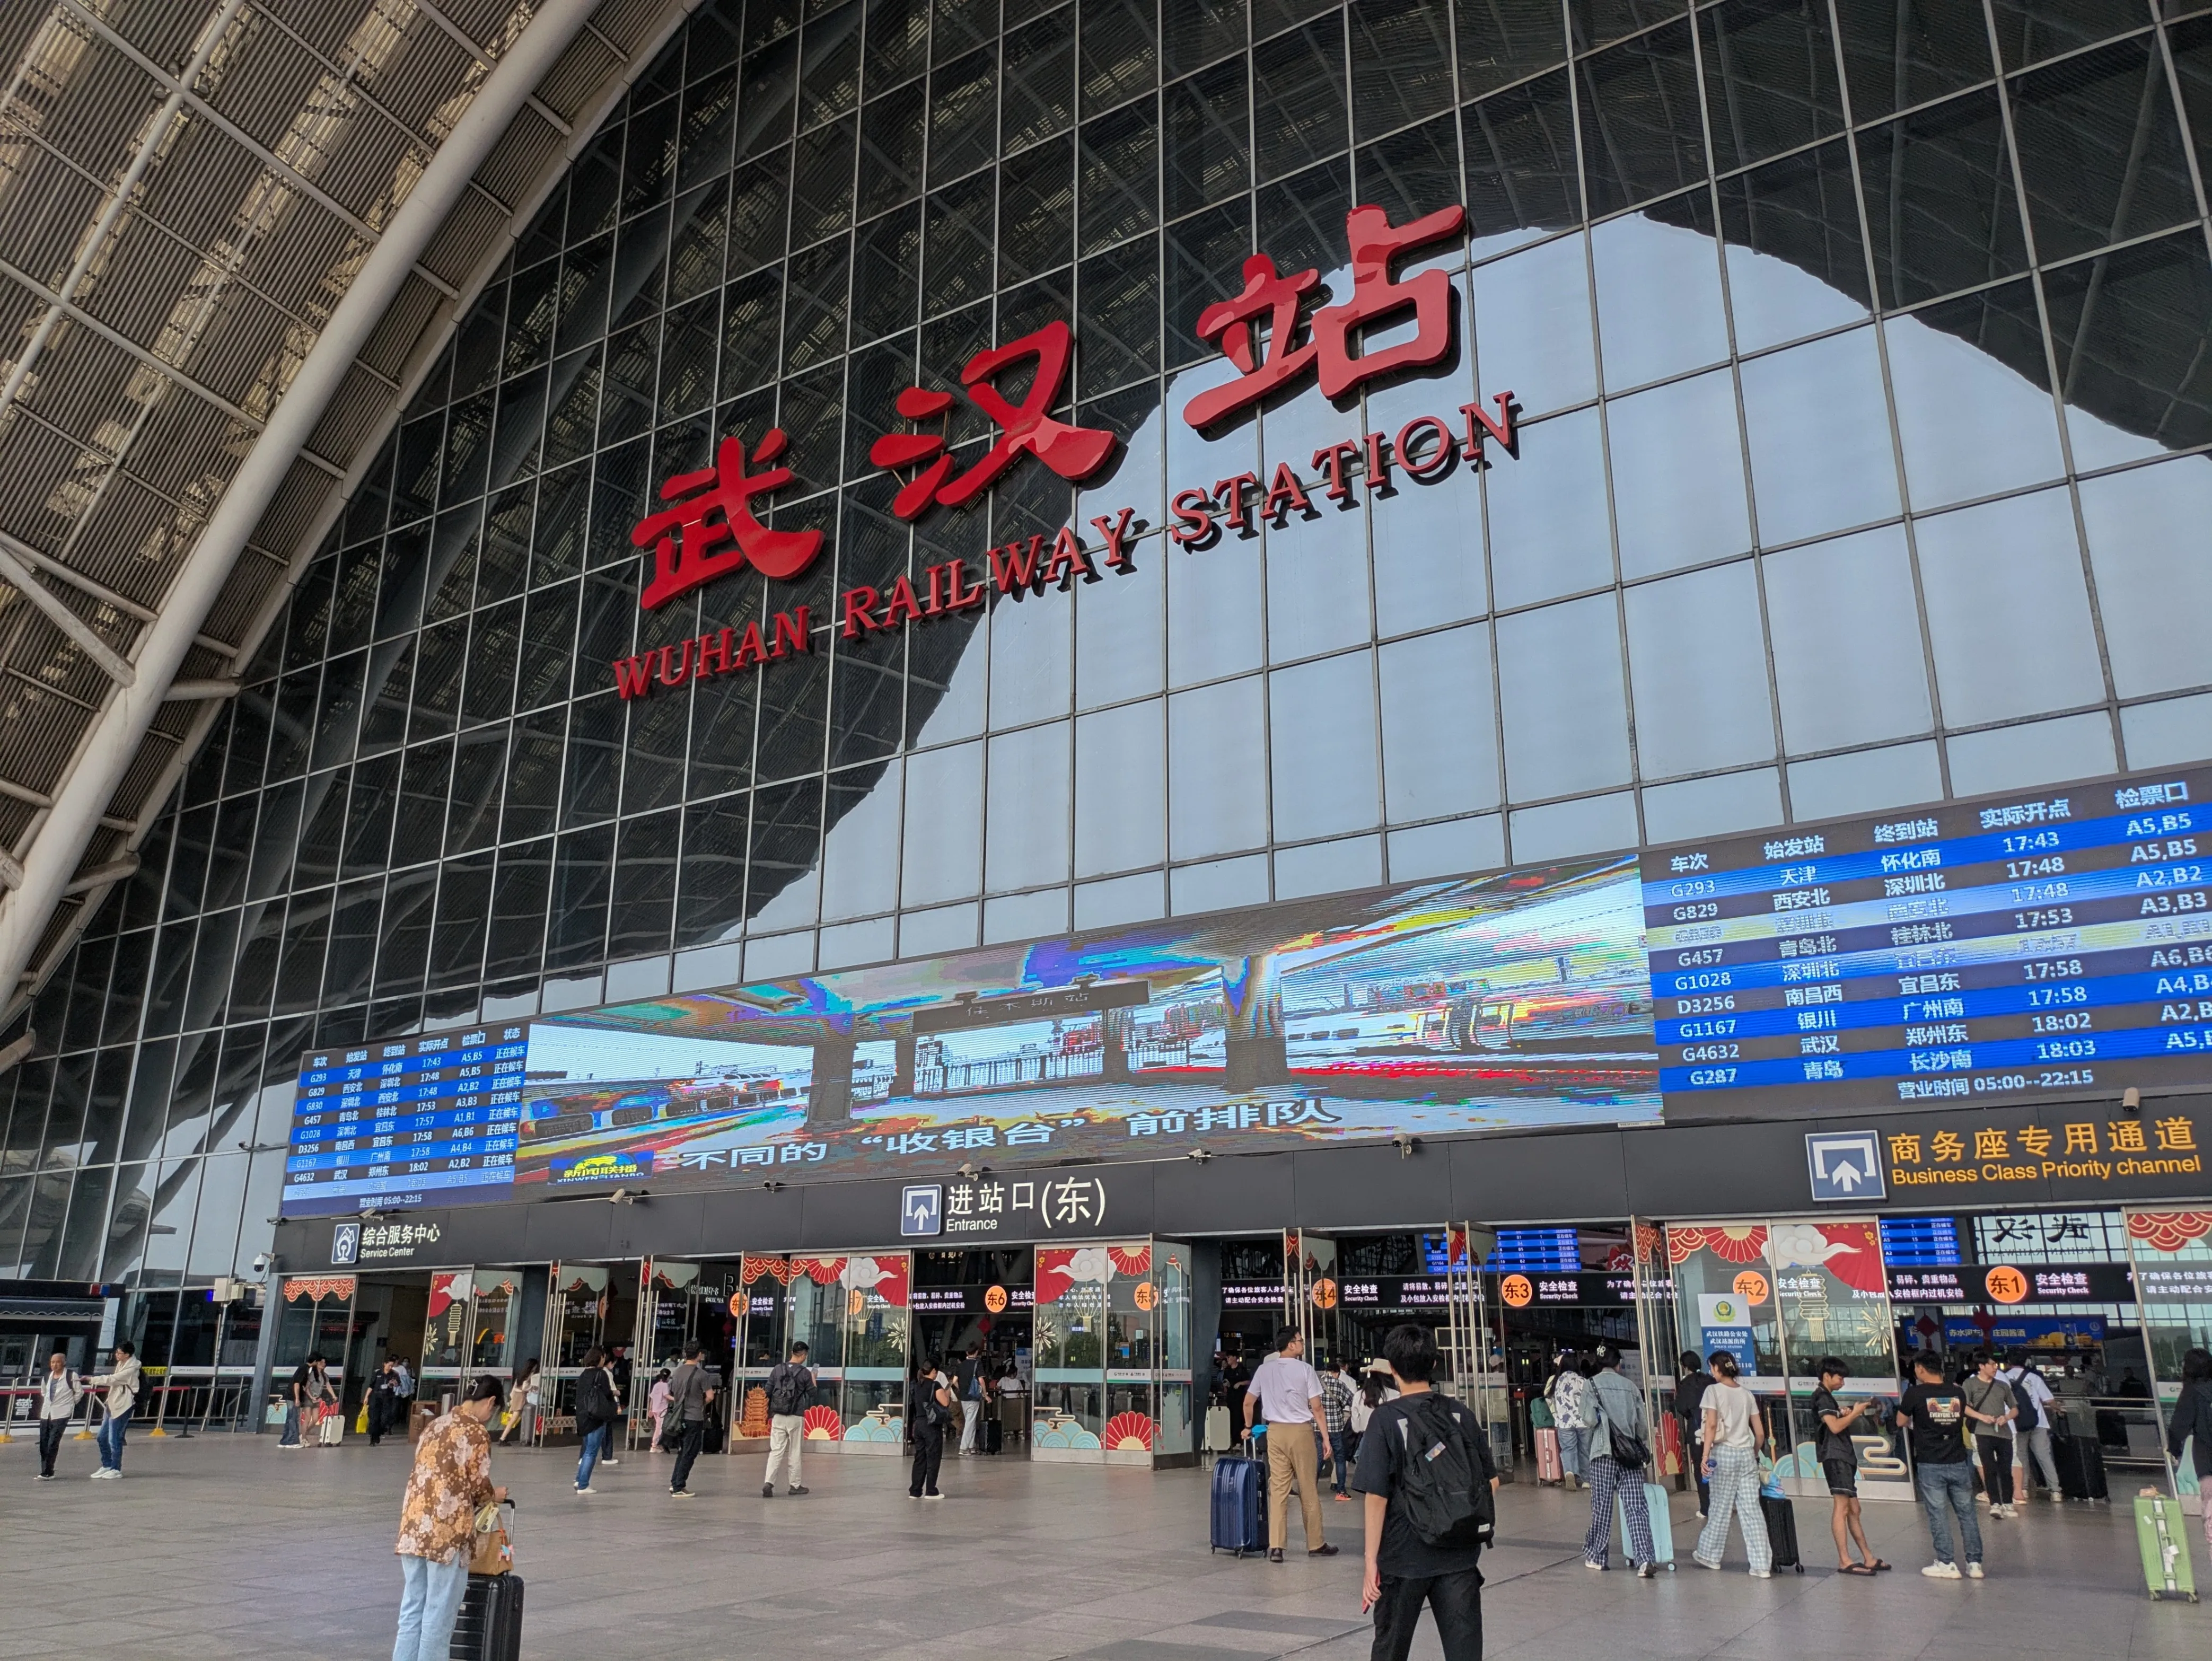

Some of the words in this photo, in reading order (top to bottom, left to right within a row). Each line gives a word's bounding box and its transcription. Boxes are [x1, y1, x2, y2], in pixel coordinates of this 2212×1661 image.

[630, 204, 1463, 610] 武汉站
[612, 605, 810, 700] WUHAN
[841, 509, 1132, 637] RAILWAY
[1171, 393, 1510, 541] STATION
[1671, 853, 1708, 872] 车次
[1764, 835, 1824, 859] 始发站
[1874, 819, 1938, 842] 终到站
[1980, 798, 2071, 829] 实际开点
[2115, 781, 2189, 809] 检票口
[1671, 880, 1715, 897] G293
[1780, 866, 1816, 885] 天津
[1881, 849, 1941, 872] 怀化南
[2003, 832, 2059, 853] 17:43
[2126, 813, 2191, 835] A5,B5
[1674, 903, 1718, 920] G829
[1772, 887, 1830, 911] 西安北
[1884, 873, 1945, 897] 深圳北
[2007, 857, 2064, 878] 17:48
[2131, 839, 2197, 862] A5,B5
[2011, 882, 2068, 902] 17:48
[2136, 866, 2201, 887] A2,B2
[1678, 948, 1724, 966] G457
[1779, 936, 1837, 958] 青岛北
[1891, 922, 1953, 945] 桂林北
[2015, 908, 2073, 929] 17:53
[2140, 892, 2207, 914] A3,B3
[1675, 972, 1731, 990] G1028
[1781, 961, 1840, 982] 深圳北
[1678, 996, 1735, 1014] D3256
[1785, 985, 1842, 1006] 南昌西
[1898, 973, 1961, 995] 宜昌东
[2024, 960, 2083, 980] 17:58
[1680, 1020, 1736, 1038] G1167
[1797, 1009, 1837, 1030] 银川
[1903, 998, 1964, 1021] 广州南
[2028, 986, 2087, 1006] 17:58
[313, 1056, 328, 1068] 车次
[346, 1050, 368, 1063] 始发站
[383, 1044, 406, 1057] 终到站
[418, 1038, 449, 1052] 实际开点
[462, 1030, 486, 1047] 检票口
[504, 1027, 521, 1040] 状态
[1682, 1044, 1740, 1061] G4632
[1800, 1035, 1840, 1054] 武汉
[1906, 1024, 1969, 1046] 郑州东
[2032, 1013, 2092, 1033] 18:02
[308, 1087, 325, 1097] G829
[343, 1082, 363, 1094] 西安北
[380, 1077, 401, 1089] 深圳北
[420, 1072, 440, 1083] 17:48
[459, 1066, 481, 1078] A5,B5
[494, 1060, 524, 1074] 正在候车
[310, 1073, 327, 1083] G293
[348, 1068, 362, 1079] 天津
[382, 1062, 403, 1075] 怀化南
[423, 1057, 441, 1068] 17:43
[461, 1051, 482, 1062] A5,B5
[495, 1045, 525, 1059] 正在候车
[1690, 1068, 1737, 1085] G287
[1803, 1060, 1843, 1080] 青岛
[1909, 1049, 1972, 1073] 长沙南
[2037, 1040, 2096, 1059] 18:03
[306, 1101, 323, 1111] G830
[340, 1096, 361, 1109] 深圳北
[378, 1091, 399, 1104] 西安北
[418, 1087, 437, 1097] 17:48
[458, 1082, 479, 1093] A2,B2
[491, 1076, 522, 1089] 正在候车
[1898, 1078, 1969, 1100] 营业时间
[1974, 1069, 2094, 1091] 05:00--22:15
[301, 1130, 321, 1139] G1028
[337, 1125, 357, 1138] 深圳北
[374, 1121, 396, 1133] 宜昌东
[415, 1116, 434, 1127] 17:57
[454, 1112, 475, 1123] A1,B1
[488, 1106, 519, 1120] 正在候车
[304, 1115, 321, 1125] G457
[339, 1110, 359, 1123] 青岛北
[376, 1106, 397, 1118] 桂林北
[417, 1101, 436, 1112] 17:53
[455, 1096, 477, 1108] A3,B3
[490, 1091, 520, 1105] 正在候车
[298, 1144, 319, 1154] D3256
[335, 1139, 355, 1152] 南昌西
[373, 1136, 394, 1147] 宜昌东
[413, 1131, 432, 1142] 17:58
[452, 1127, 474, 1138] A6,B6
[487, 1122, 517, 1136] 正在候车
[680, 1141, 828, 1170] 不同的
[1126, 1100, 1340, 1137] 前排队
[1887, 1116, 2197, 1165] 商务座专用通道
[294, 1173, 314, 1182] G4632
[333, 1170, 348, 1180] 武汉
[368, 1166, 390, 1177] 郑州东
[409, 1162, 428, 1172] 18:02
[448, 1158, 470, 1169] A2,B2
[482, 1154, 513, 1167] 正在候车
[296, 1158, 317, 1168] G1167
[336, 1155, 350, 1165] 银川
[371, 1150, 391, 1162] 广州南
[411, 1147, 430, 1157] 17:58
[450, 1143, 472, 1154] A4,B4
[485, 1138, 515, 1152] 正在候车
[564, 1164, 637, 1177] 新闻联播
[1892, 1165, 1979, 1186] Business
[1981, 1163, 2038, 1181] Class
[2042, 1158, 2111, 1180] Priority
[2116, 1154, 2201, 1175] channel
[362, 1223, 441, 1246] 综合服务中心
[946, 1218, 998, 1232] Entrance
[361, 1247, 387, 1259] Service
[389, 1247, 415, 1257] Center
[1345, 1284, 1378, 1294] 安全检查
[1504, 1282, 1529, 1299] 东3
[1539, 1280, 1577, 1291] 安全检查
[1736, 1279, 1766, 1297] 东2
[1778, 1277, 1821, 1289] 安全检查
[1989, 1275, 2021, 1294] 东1
[2035, 1273, 2088, 1286] 安全检查
[2038, 1287, 2066, 1296] Security
[987, 1292, 1005, 1306] 东6
